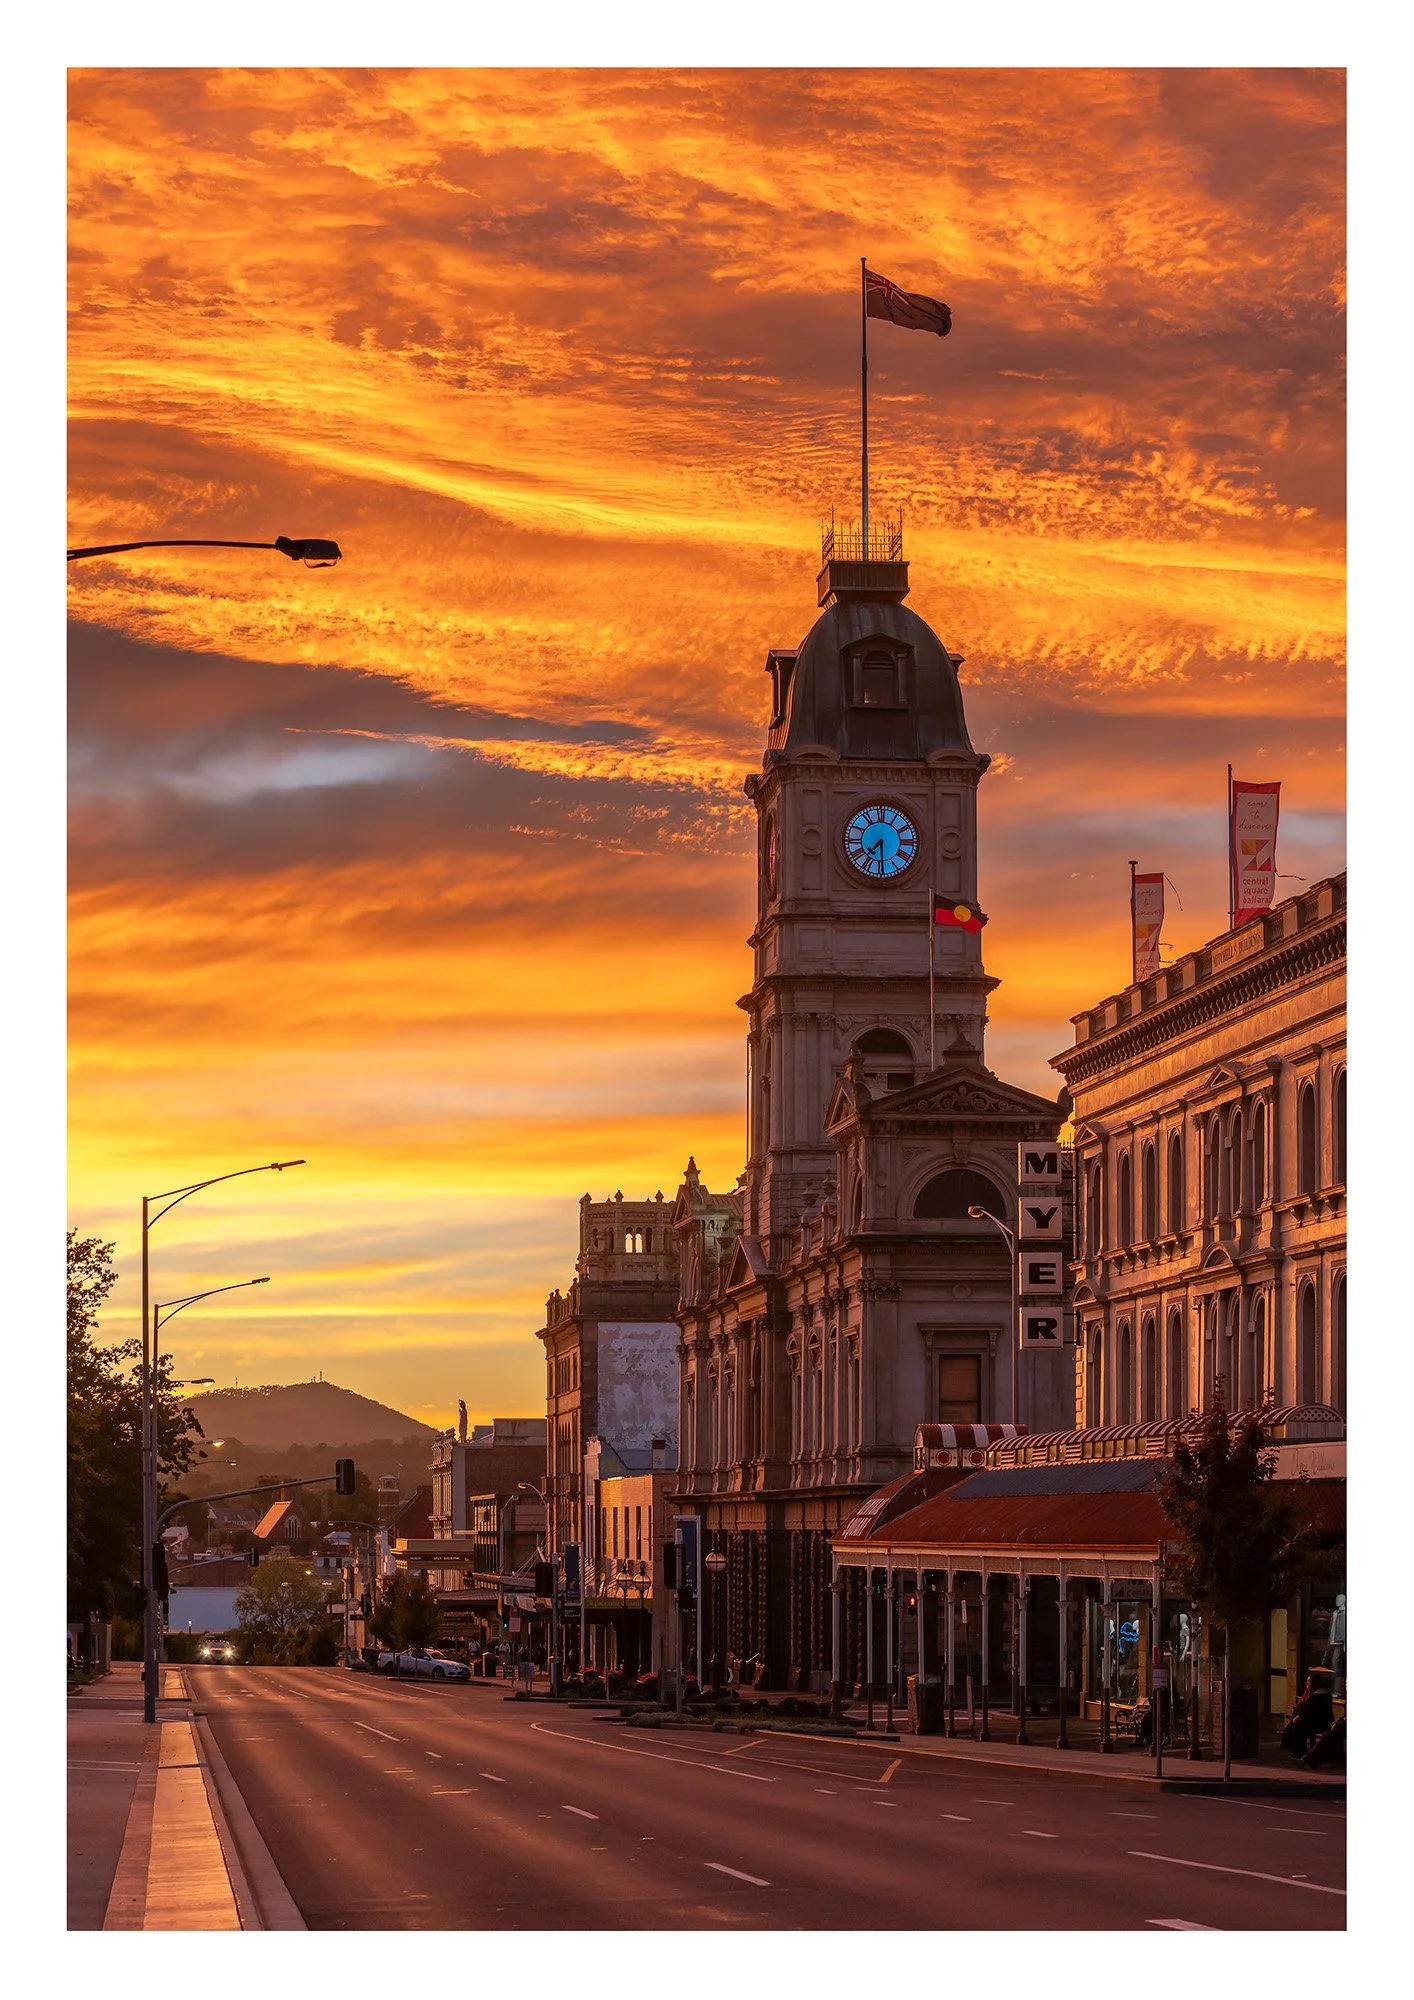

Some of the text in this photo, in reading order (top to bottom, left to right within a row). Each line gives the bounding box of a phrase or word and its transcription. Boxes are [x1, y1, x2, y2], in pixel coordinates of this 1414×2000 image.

[1242, 876, 1269, 885] central
[1243, 886, 1269, 896] square
[1025, 1152, 1058, 1340] MYER
